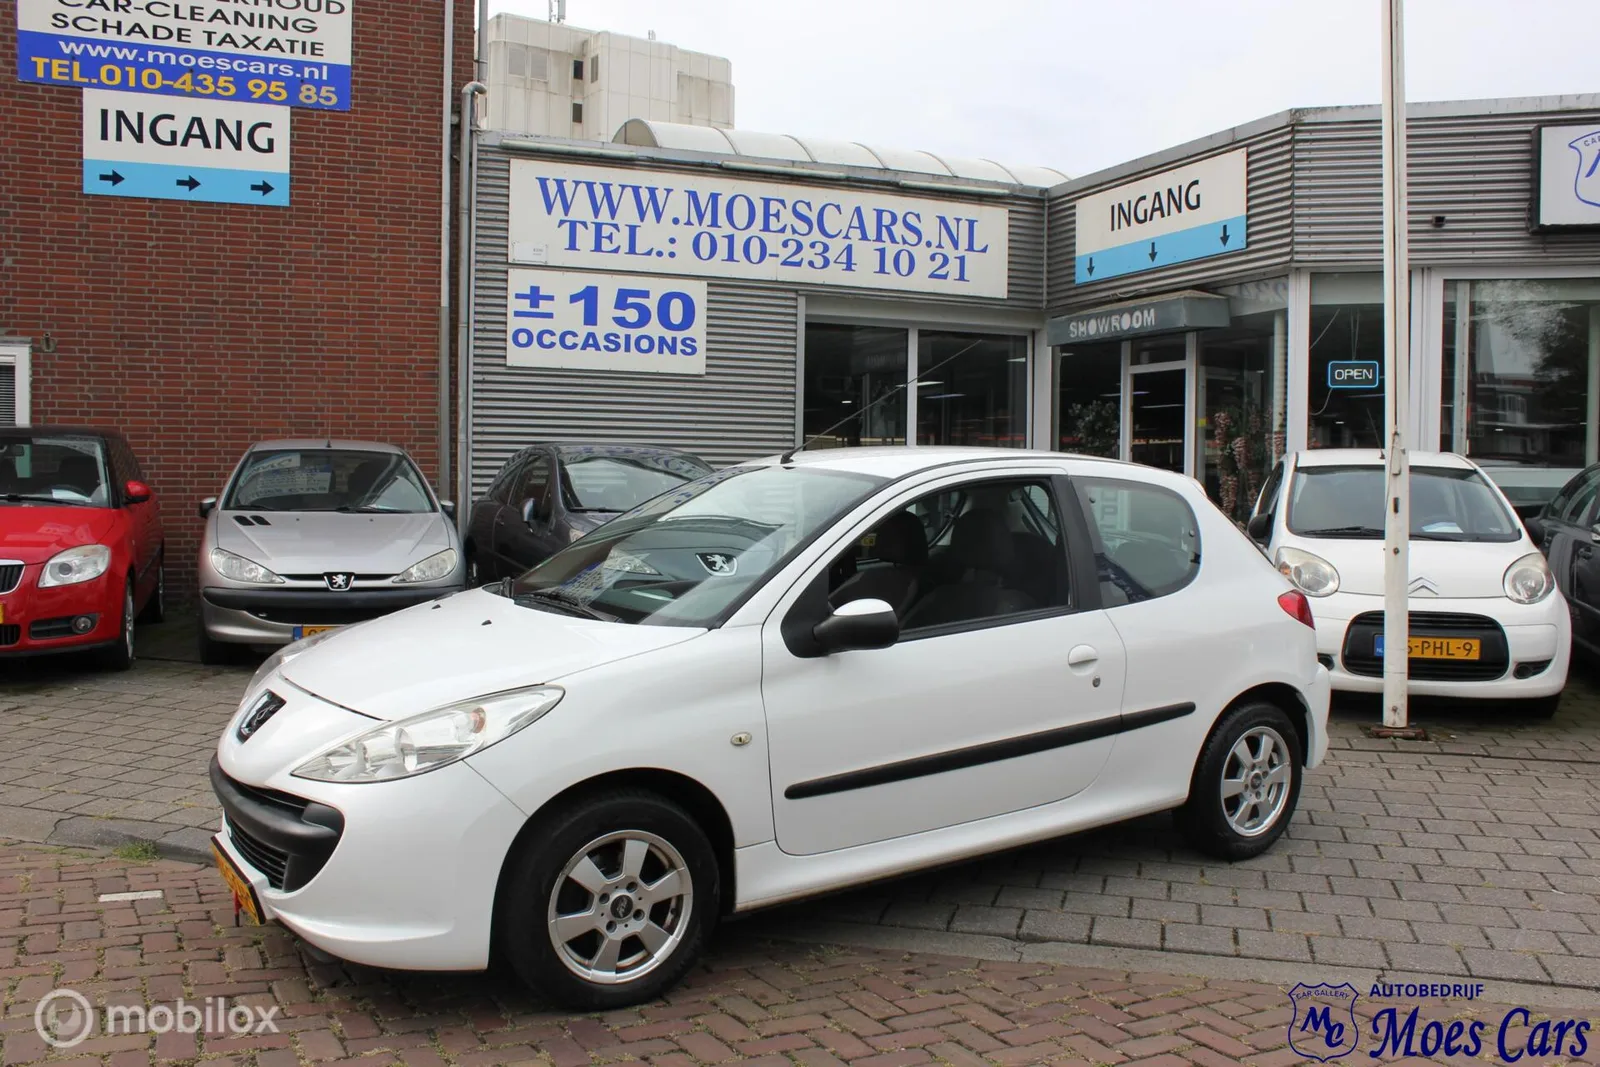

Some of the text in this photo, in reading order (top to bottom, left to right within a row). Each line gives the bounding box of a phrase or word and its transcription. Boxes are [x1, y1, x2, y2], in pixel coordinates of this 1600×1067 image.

[51, 13, 324, 57] SCHADE TAXATIE
[58, 40, 328, 80] www.moescars.nl
[247, 79, 288, 101] 95
[298, 84, 338, 106] 85
[100, 108, 275, 154] INGANG
[535, 176, 989, 254] WWW.MOESCARS.NL
[1110, 179, 1201, 232] INGANG
[557, 219, 971, 283] TEL.: 010-234 10 21
[511, 328, 698, 357] OCCASIONS
[1069, 308, 1155, 338] SHOWROOM
[1335, 368, 1373, 380] OPEN
